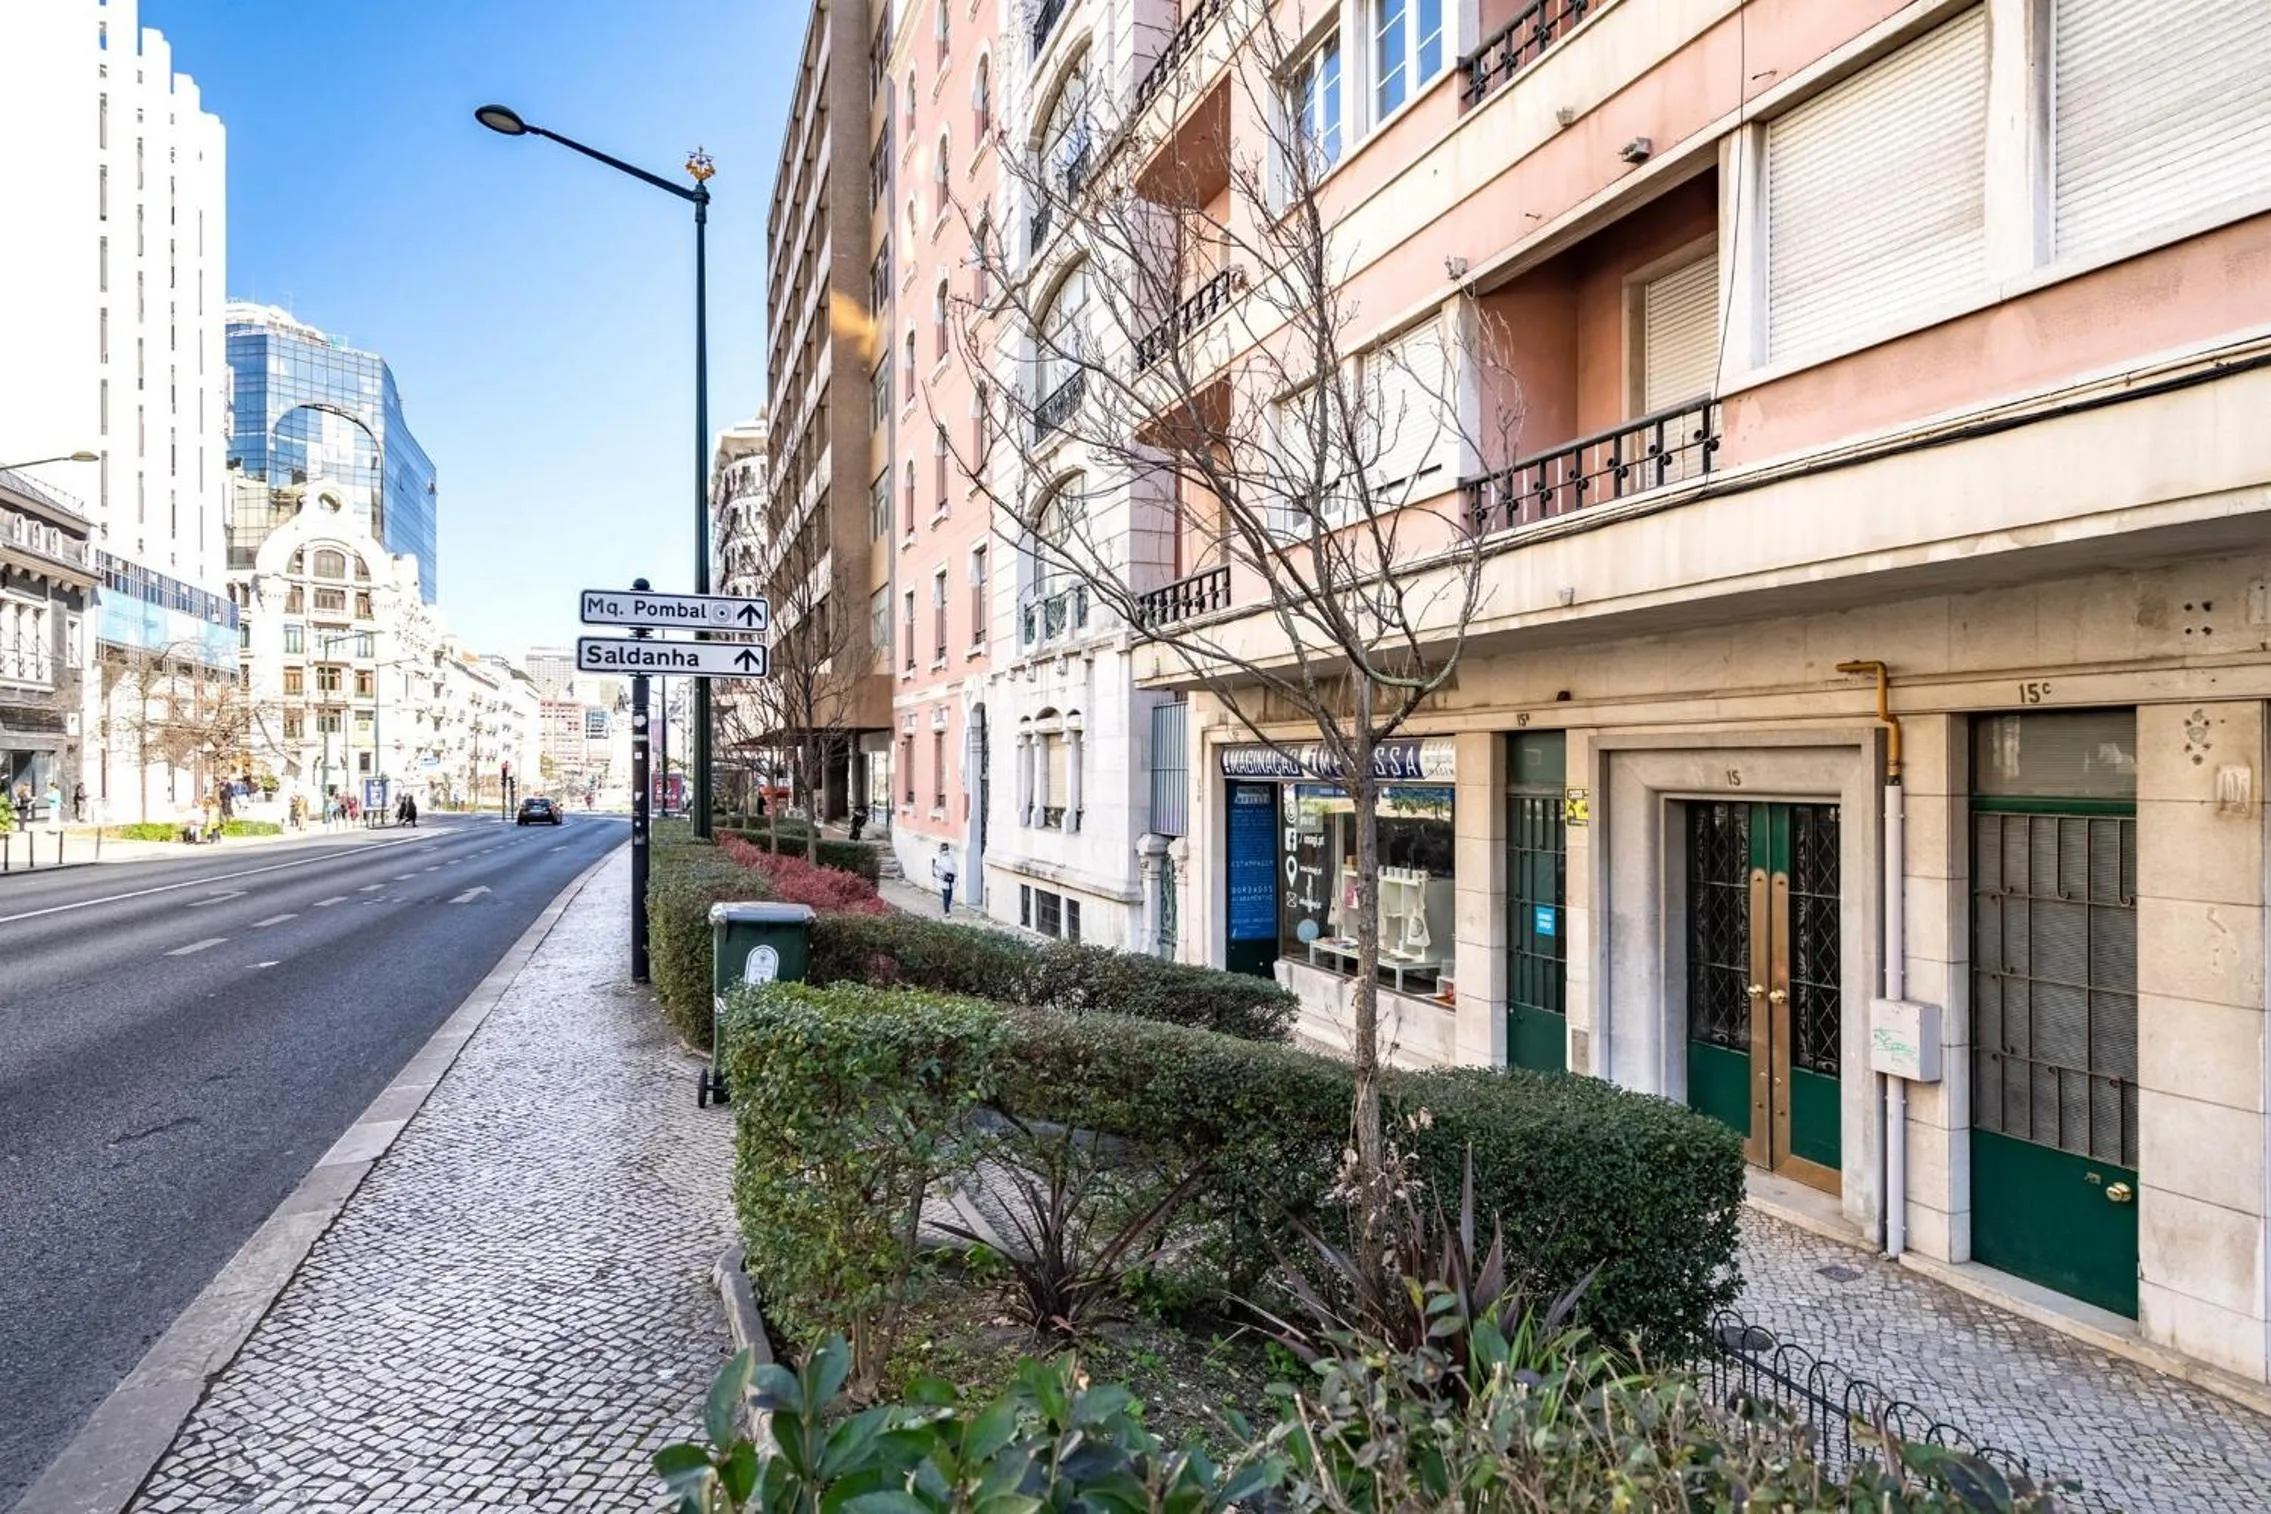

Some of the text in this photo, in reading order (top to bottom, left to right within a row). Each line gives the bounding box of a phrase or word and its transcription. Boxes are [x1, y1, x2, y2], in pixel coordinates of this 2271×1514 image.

[587, 597, 707, 619] Mq. Pombal
[586, 645, 700, 667] Saldanha
[1726, 769, 1742, 787] 15
